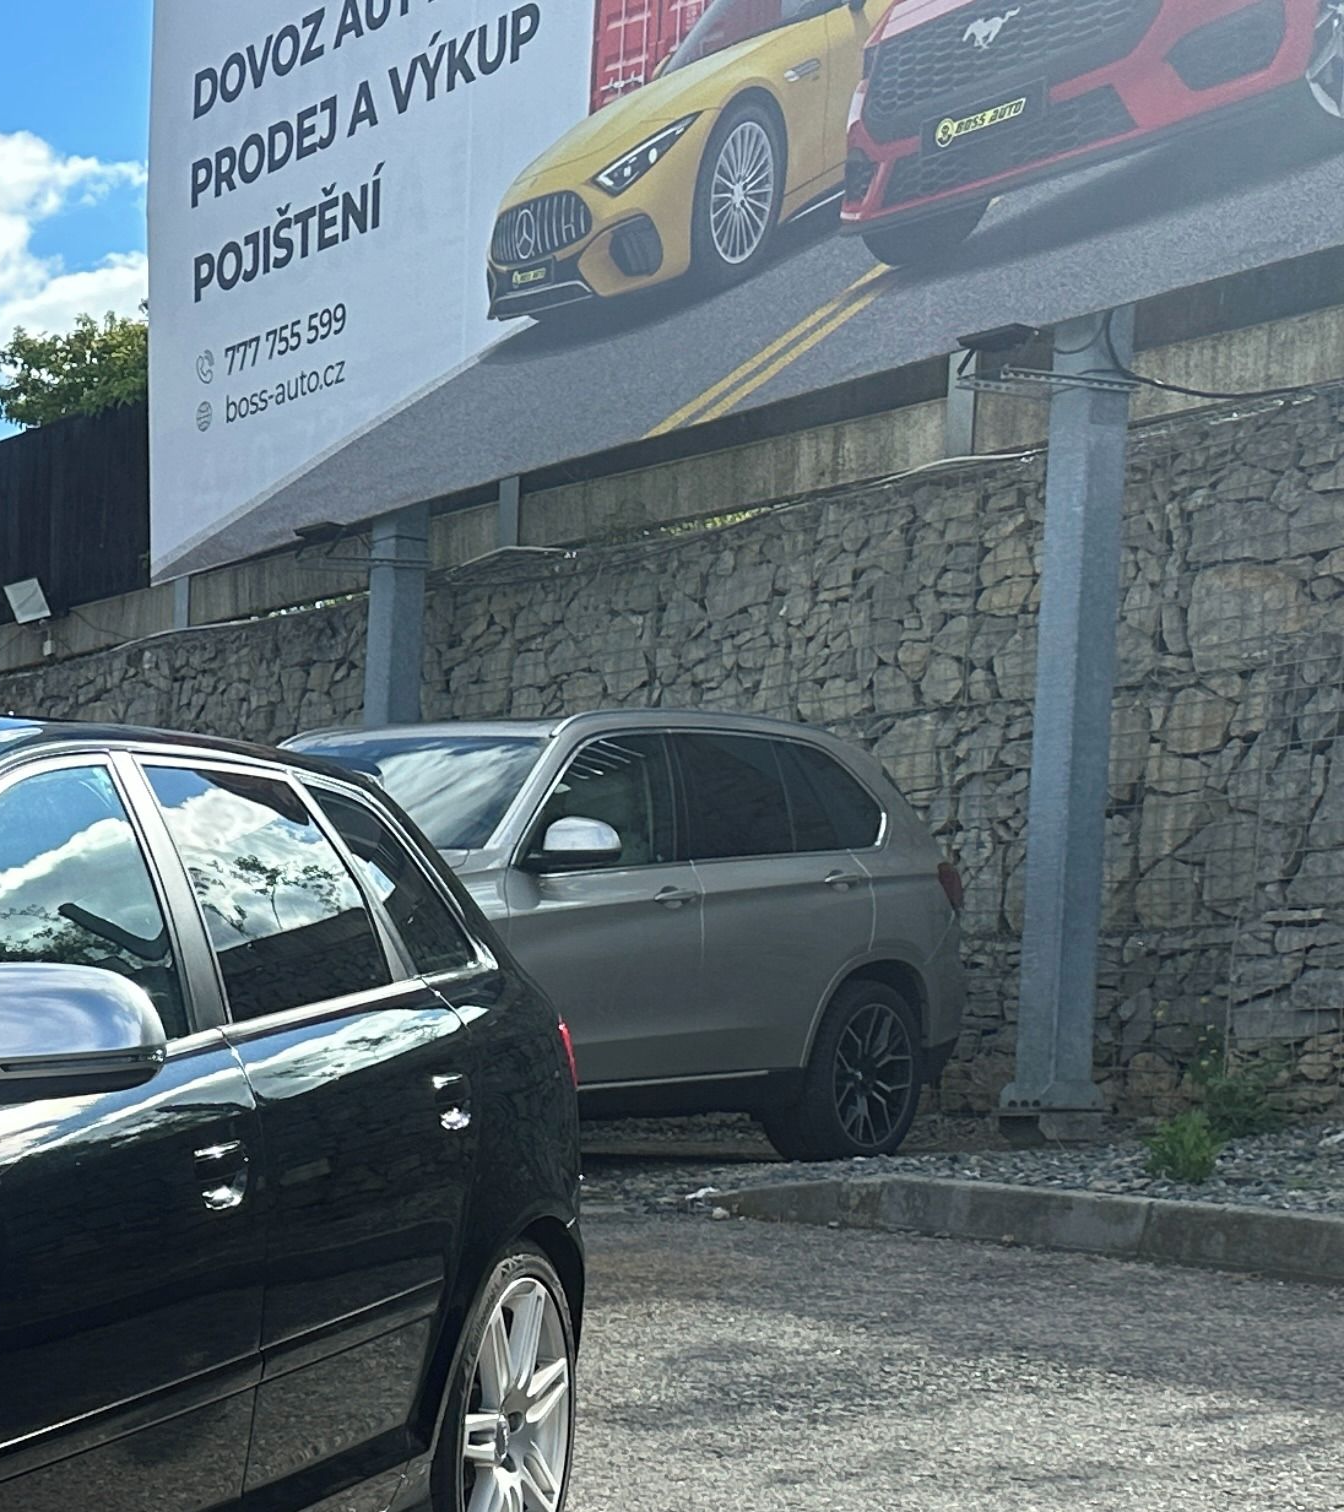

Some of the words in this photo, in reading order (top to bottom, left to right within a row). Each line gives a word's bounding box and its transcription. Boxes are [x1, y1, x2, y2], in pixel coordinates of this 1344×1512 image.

[191, 94, 338, 209] PRODEJ
[346, 80, 379, 138] A
[388, 3, 541, 115] VÝKUP
[193, 7, 326, 120] DOVOZ
[955, 114, 987, 133] BOSS
[989, 100, 1024, 123] AUTO
[194, 161, 386, 303] POJIŠTĚNÍ
[224, 335, 261, 376] 777
[265, 319, 301, 361] 755
[306, 302, 347, 345] 599
[225, 360, 346, 424] boss-auto.cz
